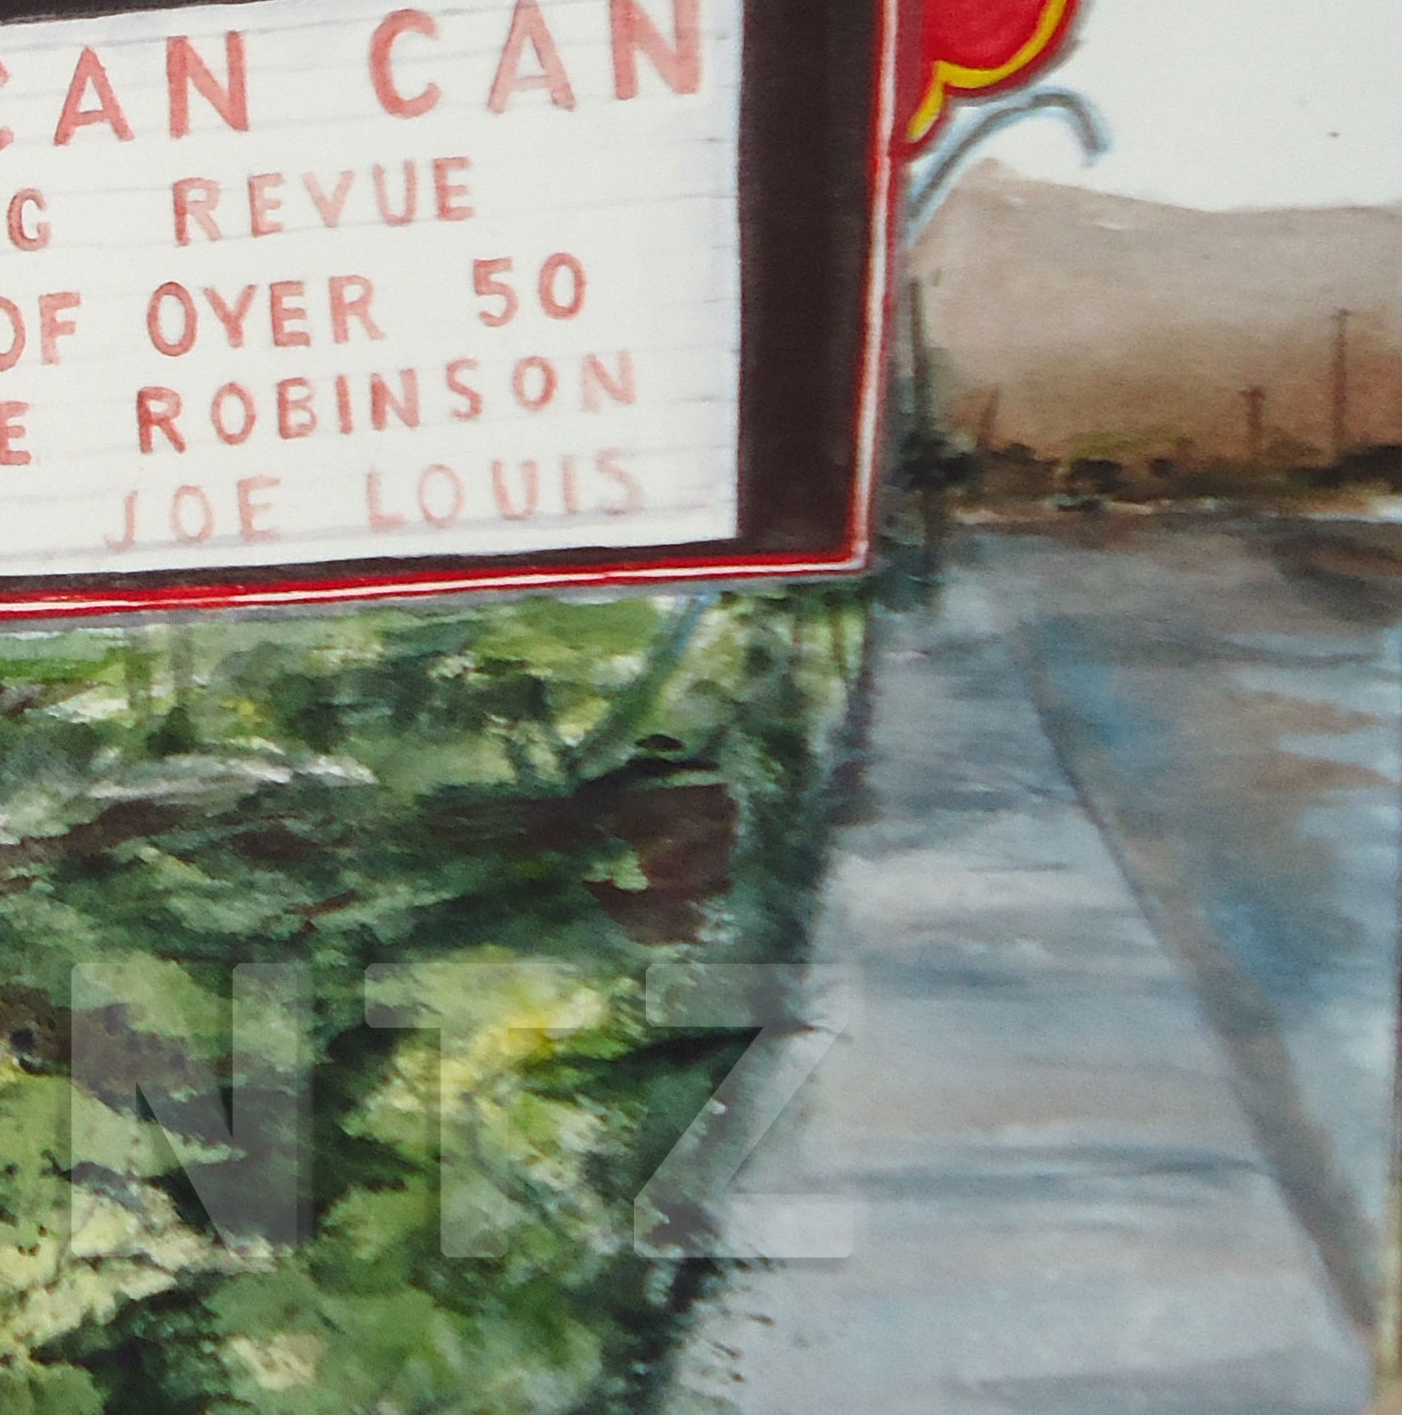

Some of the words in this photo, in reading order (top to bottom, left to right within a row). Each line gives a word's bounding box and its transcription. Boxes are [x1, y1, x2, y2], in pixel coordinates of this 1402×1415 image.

[171, 156, 475, 247] REVUE
[471, 251, 588, 329] 50
[136, 348, 639, 454] ROBINSON
[102, 474, 282, 554] JOE
[365, 447, 648, 534] LOUIS
